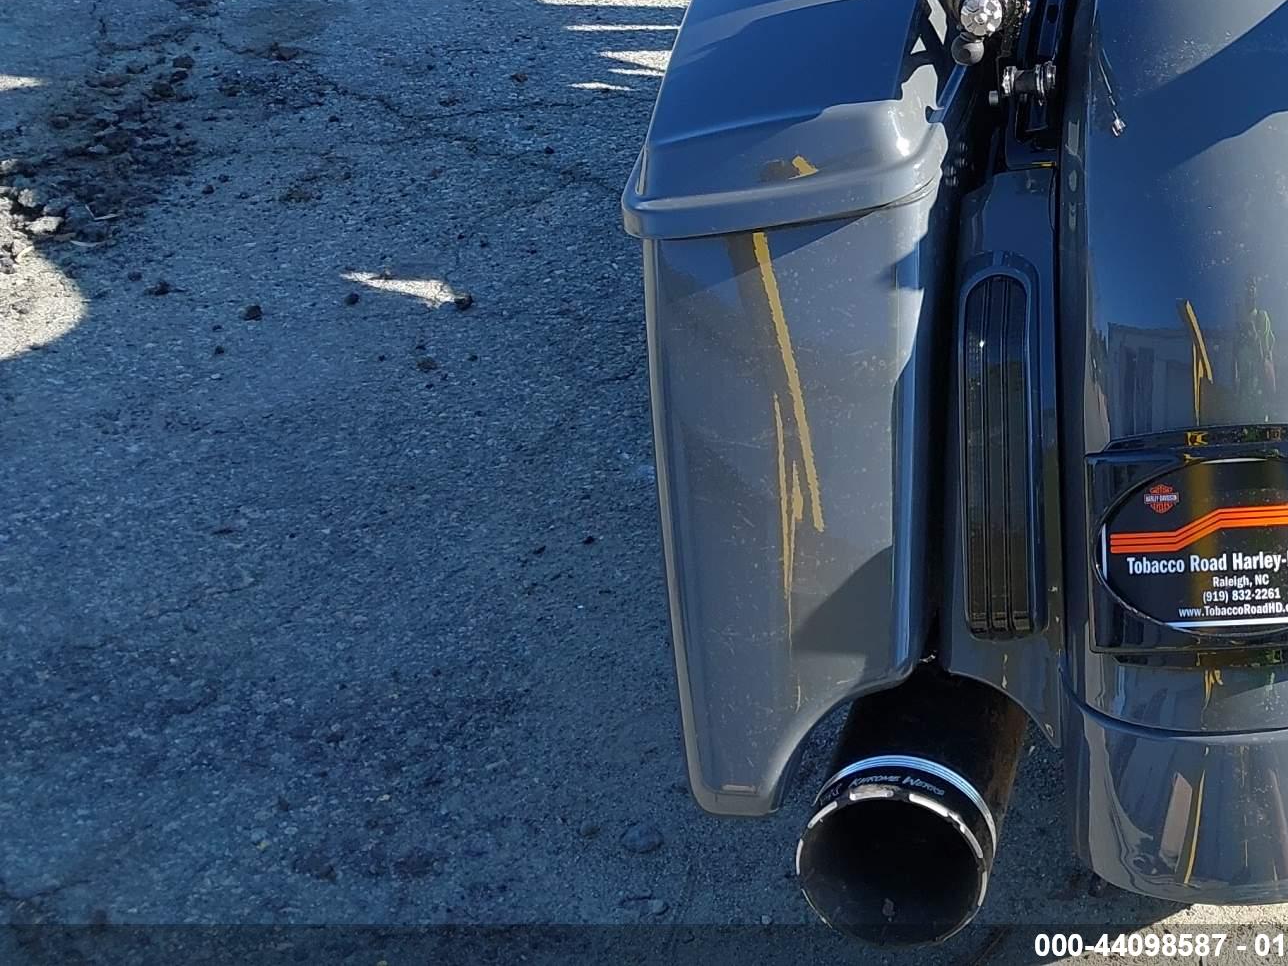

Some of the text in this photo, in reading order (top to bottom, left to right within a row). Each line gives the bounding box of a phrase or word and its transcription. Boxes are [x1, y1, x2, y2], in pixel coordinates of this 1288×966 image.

[1126, 556, 1186, 575] Tobacco
[1189, 553, 1228, 572] Road
[1212, 574, 1270, 589] Raleigh, NC
[1202, 587, 1281, 604] (919) 832-2261
